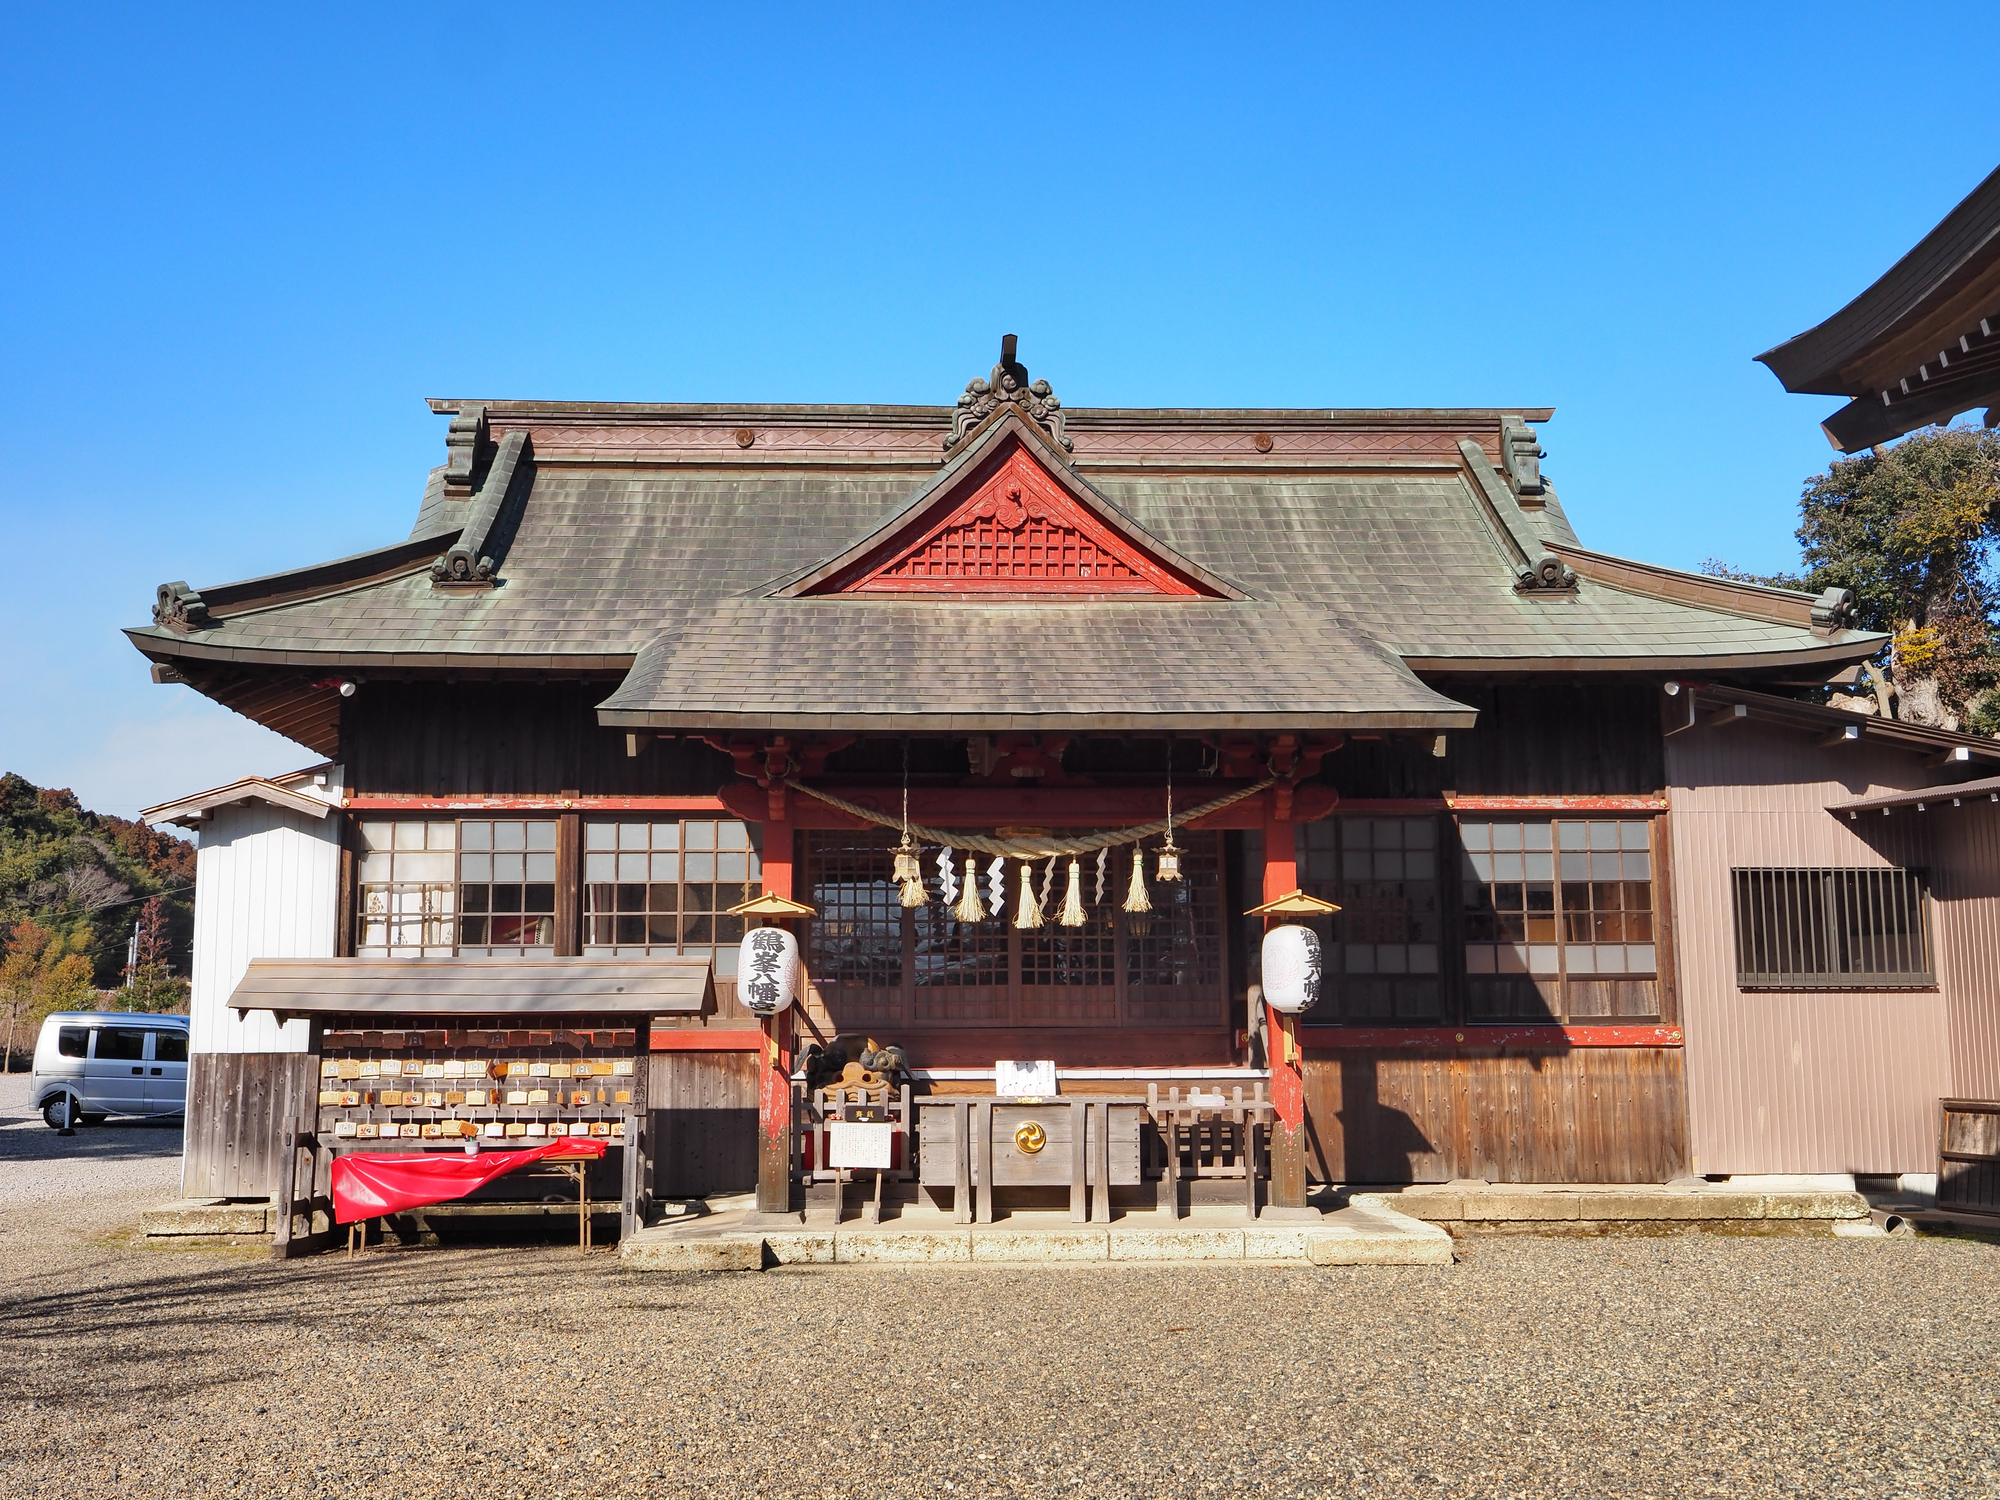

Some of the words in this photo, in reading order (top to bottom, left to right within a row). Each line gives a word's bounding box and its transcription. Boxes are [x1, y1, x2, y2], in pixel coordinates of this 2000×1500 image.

[748, 930, 785, 1011] 鶴峯八幡宮
